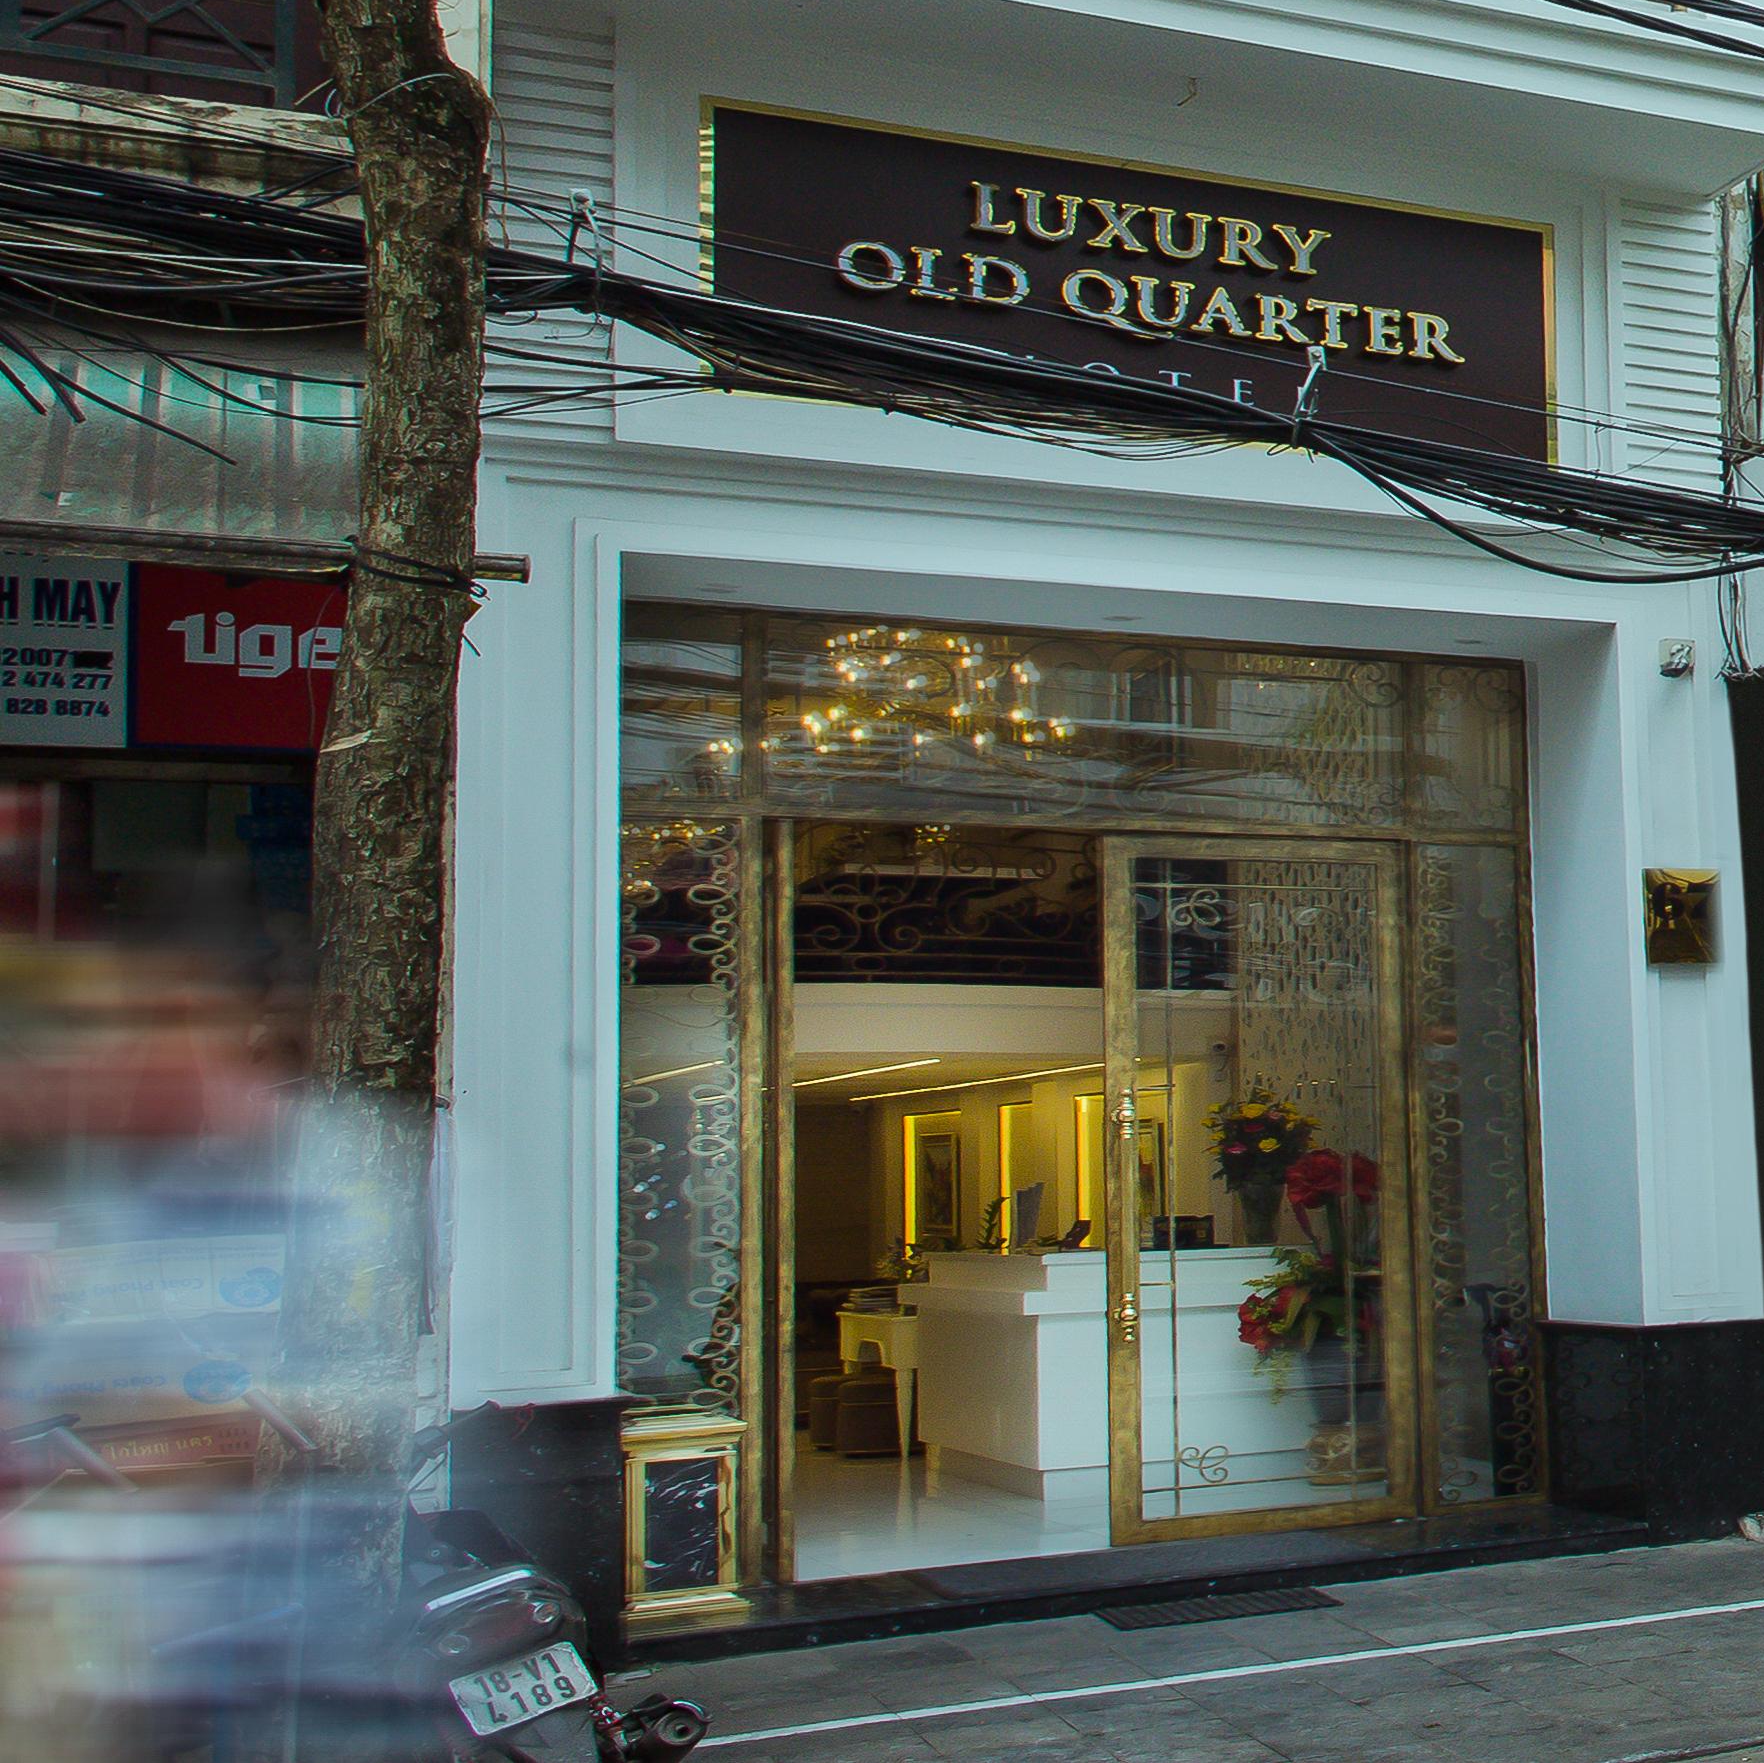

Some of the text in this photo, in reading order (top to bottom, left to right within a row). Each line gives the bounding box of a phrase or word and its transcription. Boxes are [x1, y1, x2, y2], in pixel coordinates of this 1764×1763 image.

[971, 181, 1332, 275] LUXURY
[838, 242, 1466, 364] OLD QUARTER
[34, 578, 122, 622] MAY
[22, 671, 65, 689] 474
[72, 673, 114, 691] 277
[6, 698, 111, 718] 828 8874
